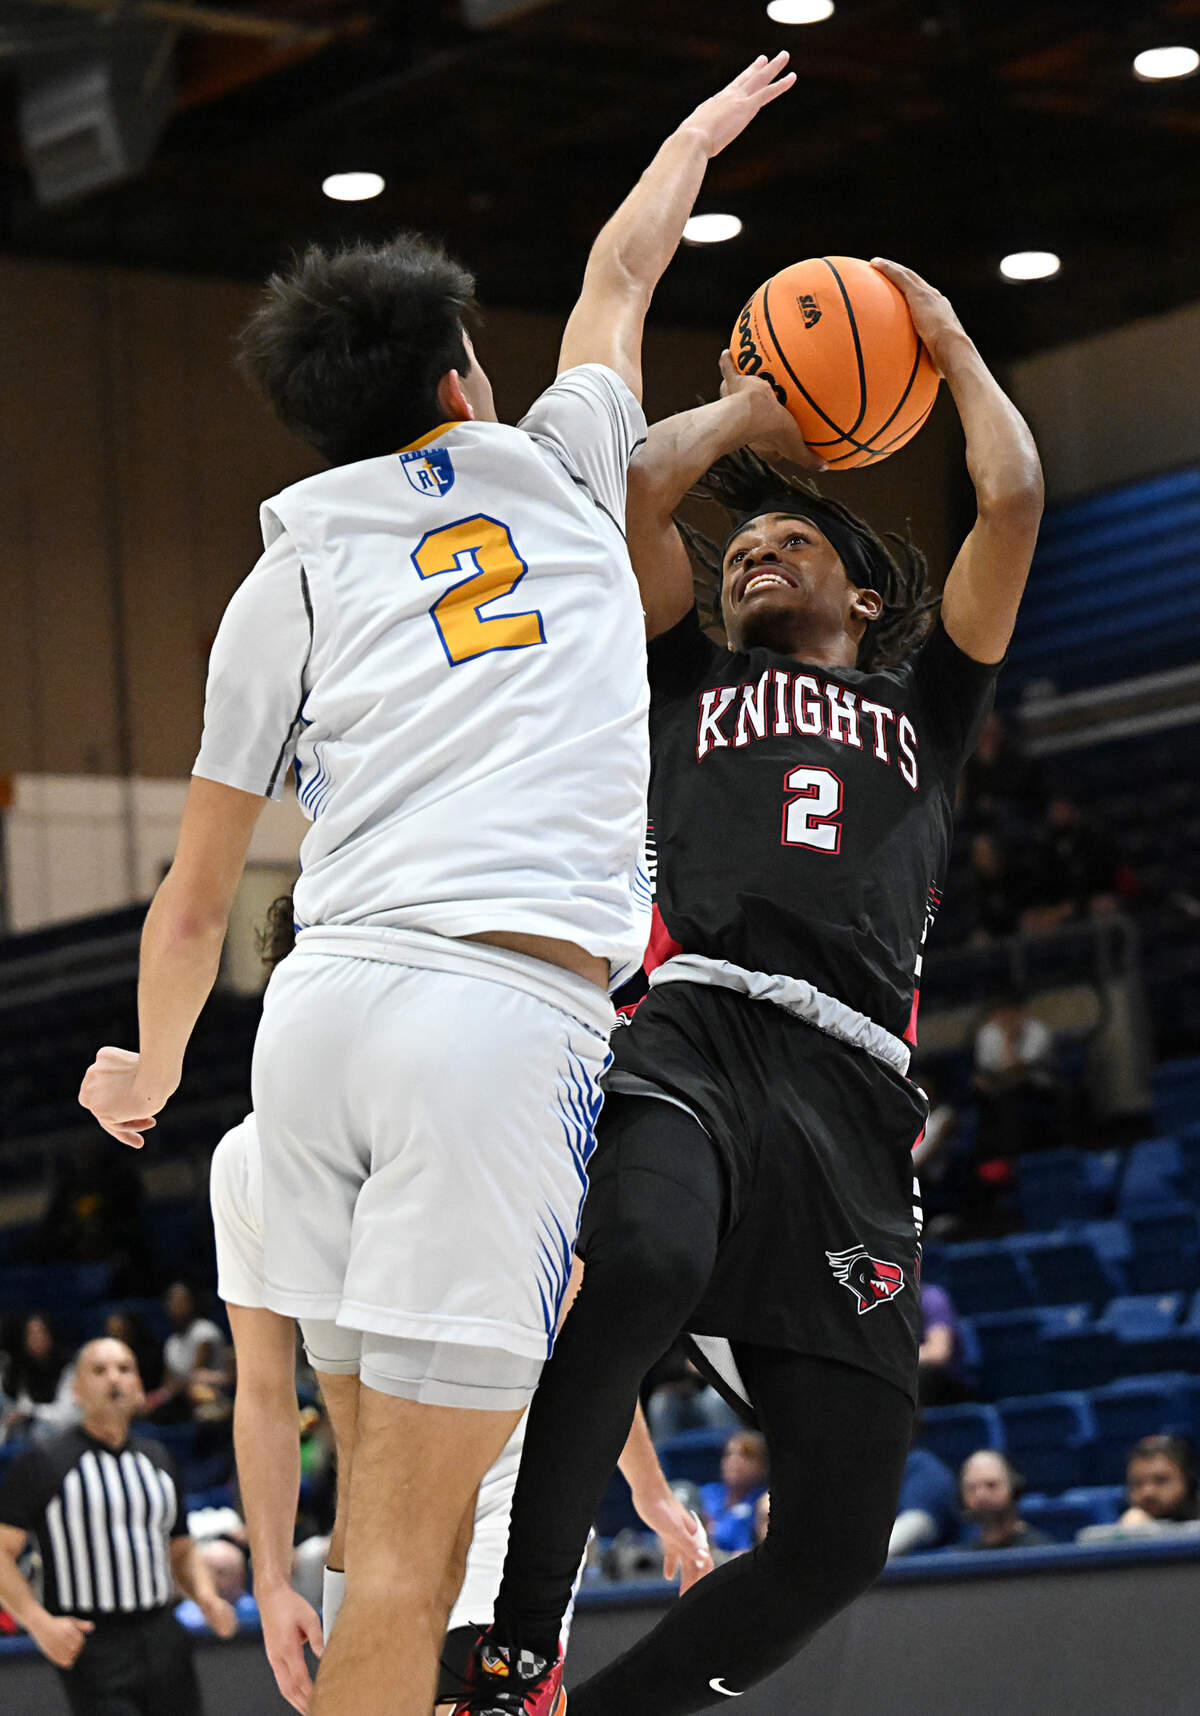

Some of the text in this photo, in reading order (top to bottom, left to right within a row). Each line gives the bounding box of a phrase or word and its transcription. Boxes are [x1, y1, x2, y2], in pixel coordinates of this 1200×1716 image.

[738, 294, 787, 406] lson
[410, 513, 547, 667] 2
[696, 667, 919, 791] KNIGHTS
[781, 765, 843, 855] 2
